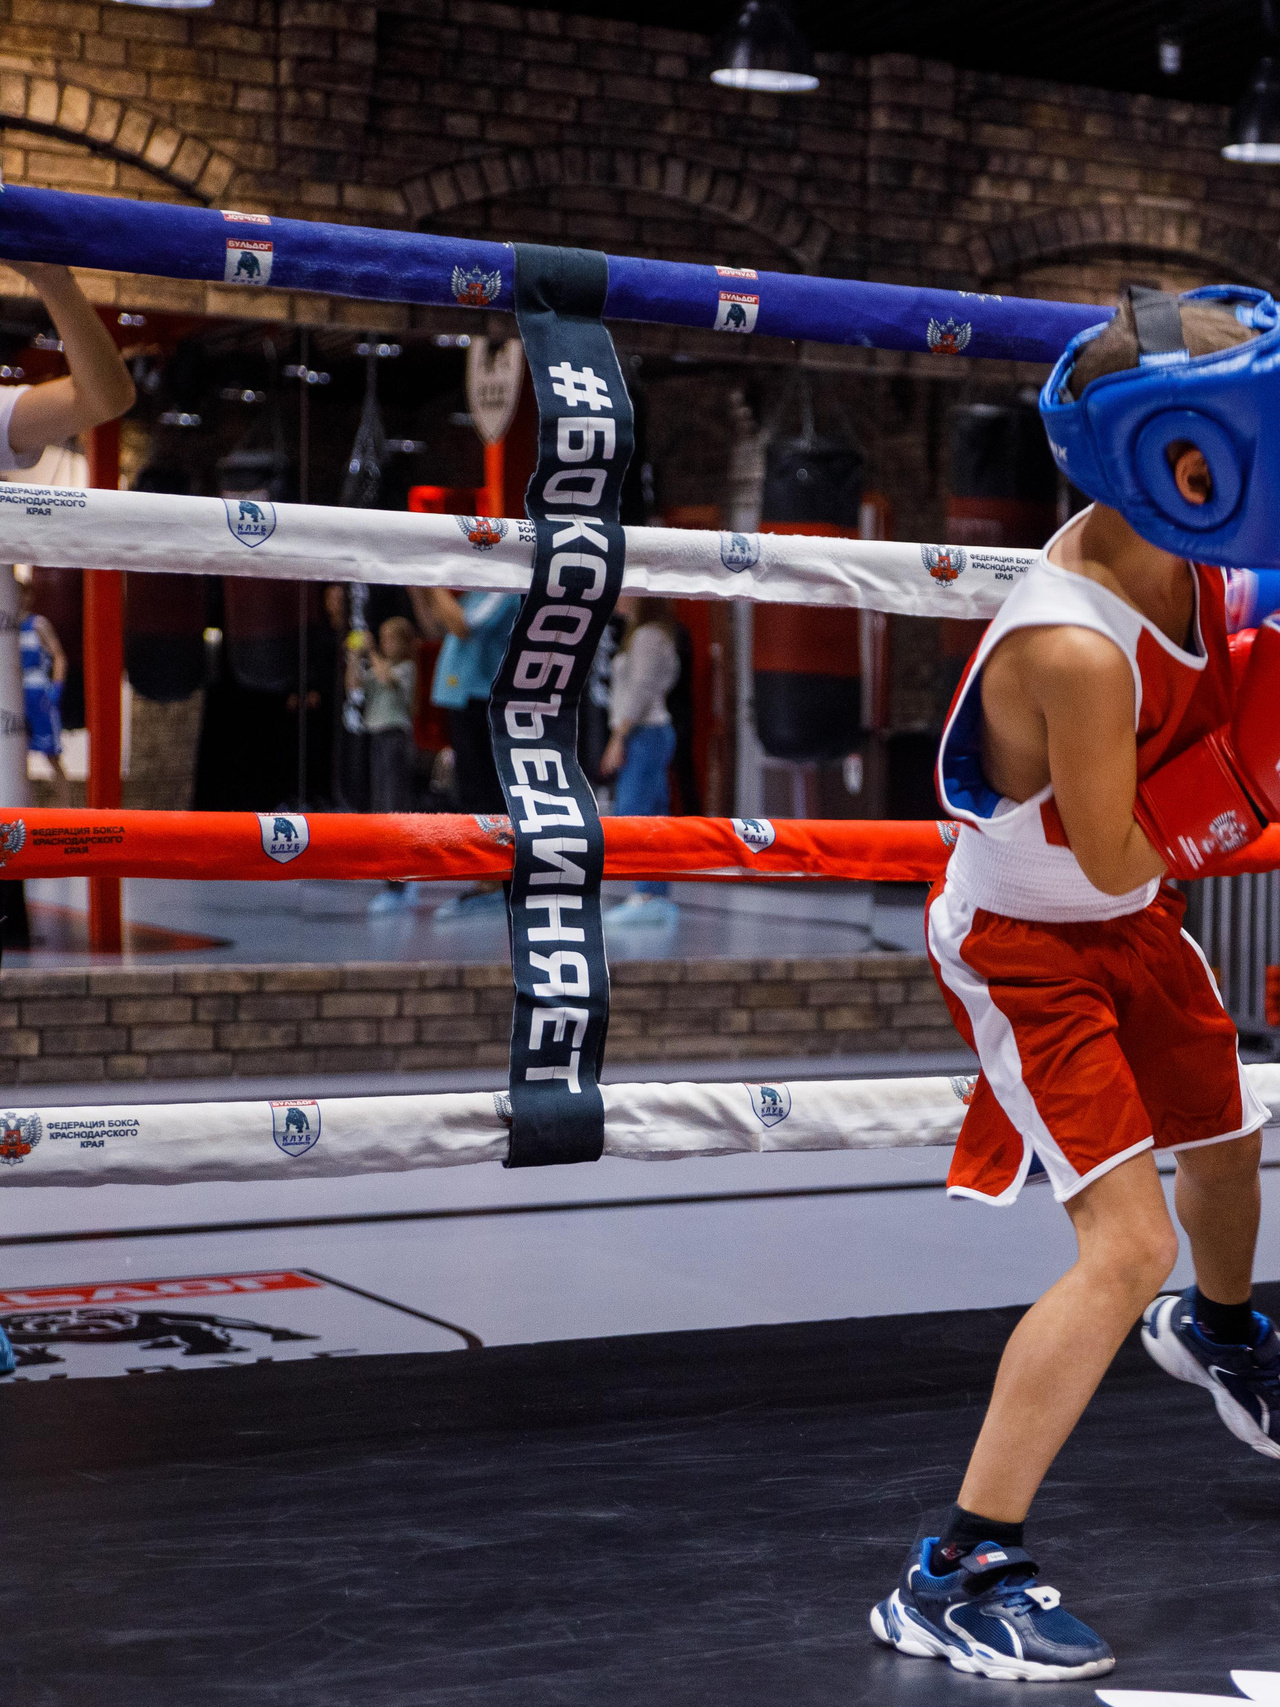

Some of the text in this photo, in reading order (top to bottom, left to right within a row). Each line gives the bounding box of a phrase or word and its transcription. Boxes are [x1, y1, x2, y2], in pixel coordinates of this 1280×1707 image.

[228, 240, 270, 250] БУЛЬДОГ
[720, 292, 757, 303] БУЛЬДОГ
[0, 486, 51, 496] ЕДЕРАЦИЯ
[0, 496, 86, 508] РАСНОДАРСКОГО
[26, 507, 51, 516] КРАЯ
[237, 523, 267, 532] КЛУБ
[970, 553, 1014, 563] ФЕДЕРАЦИЯ
[972, 561, 1028, 573] КРАСНОДАРСКО
[995, 572, 1014, 581] КРАЯ
[504, 361, 616, 1094] #БОКСОБЪЕДИНЯЕТ
[93, 826, 125, 835] БОКСА
[743, 833, 769, 842] КЛУБ
[64, 846, 89, 854] КРАЯ
[271, 843, 300, 851] КЛУБ
[761, 1106, 784, 1114] КЛУБ
[46, 1119, 140, 1130] ФЕДЕРАЦИЯ БОКСА
[49, 1129, 138, 1140] КРАСНОДАРСКОГО
[282, 1134, 311, 1142] КЛУБ
[80, 1140, 105, 1148] КРАЯ
